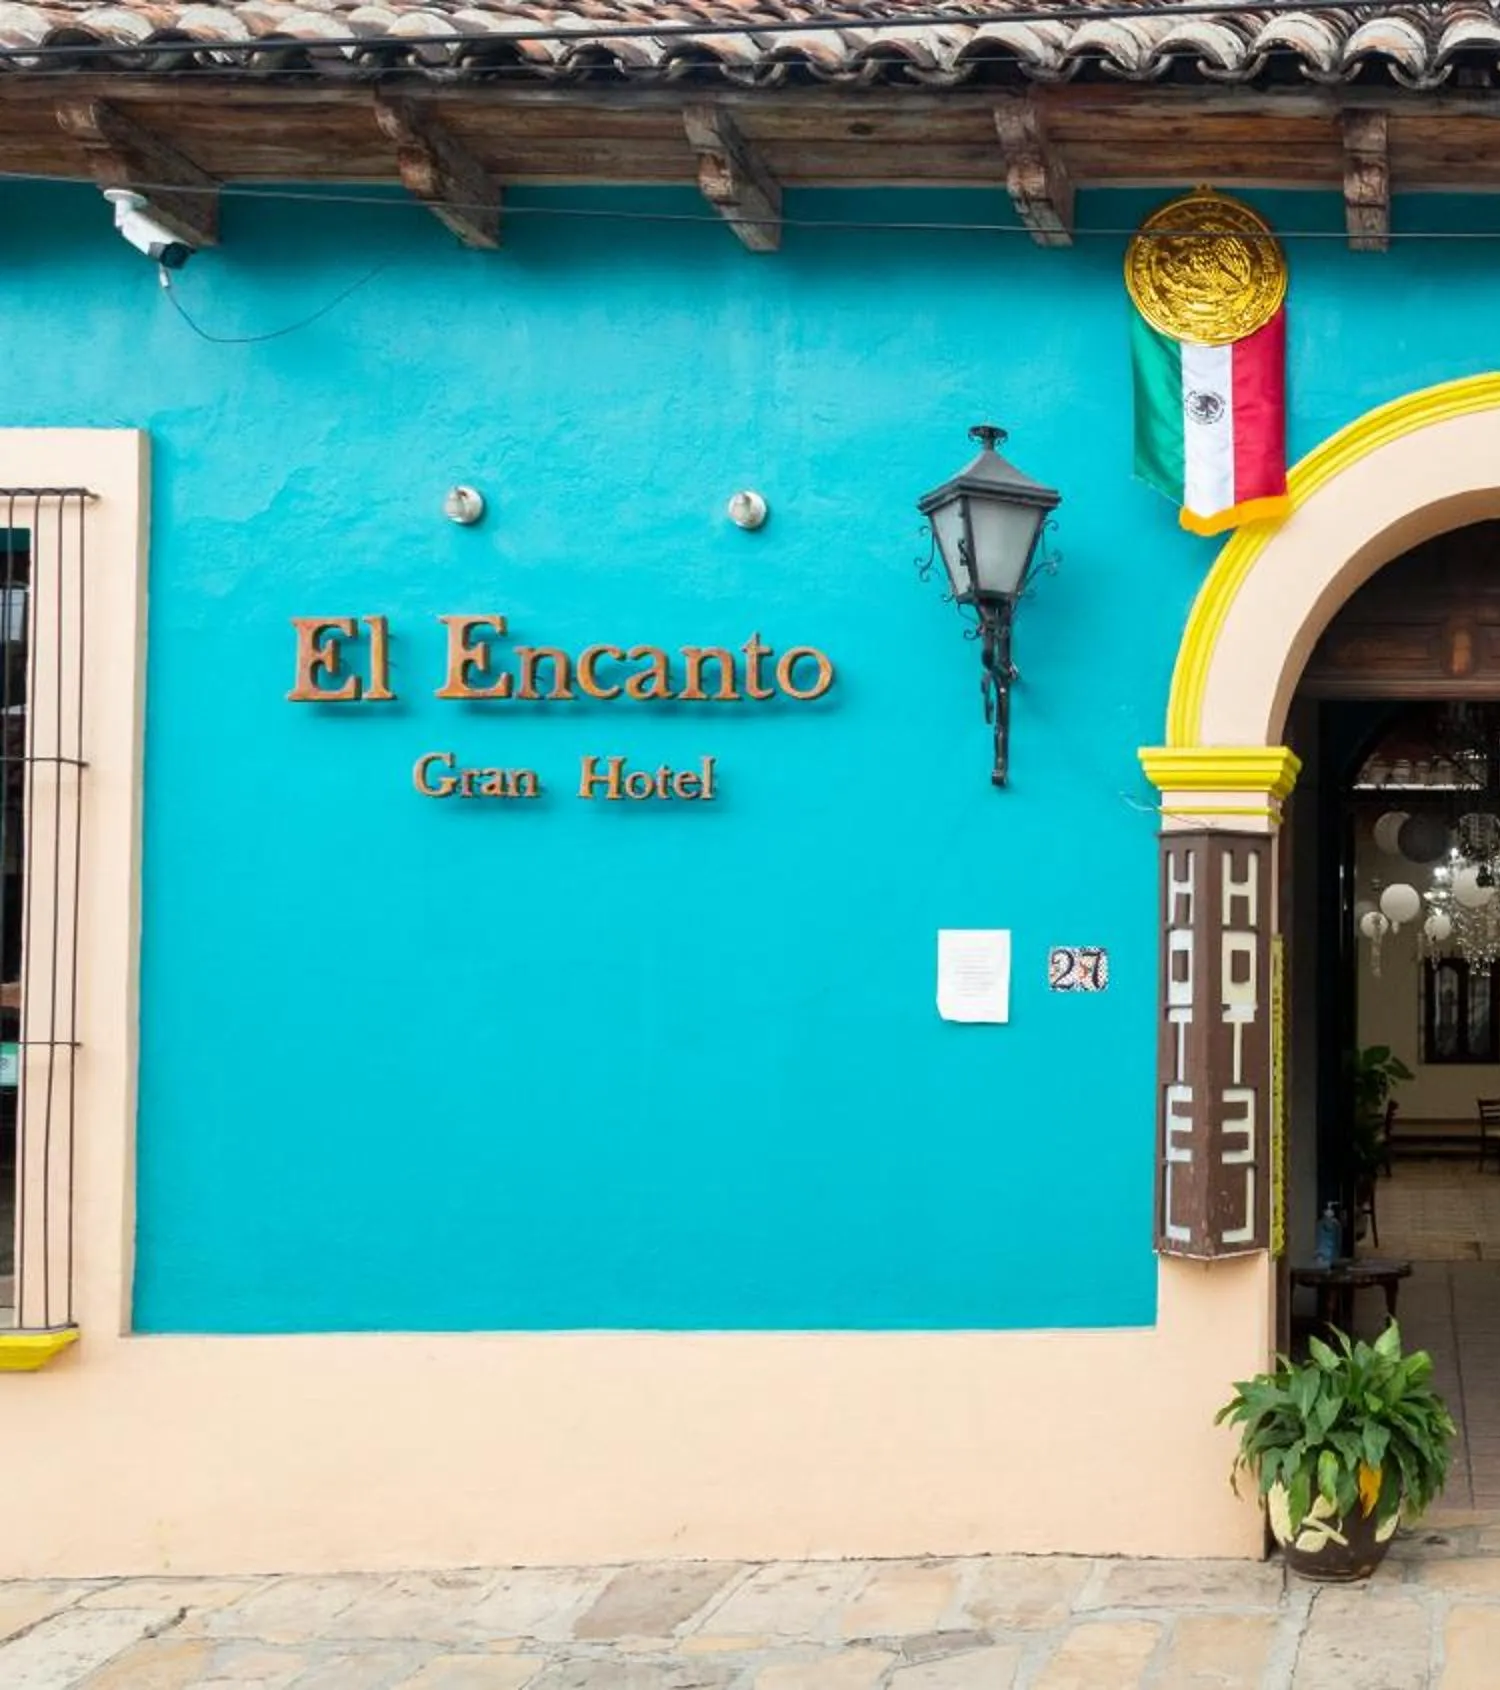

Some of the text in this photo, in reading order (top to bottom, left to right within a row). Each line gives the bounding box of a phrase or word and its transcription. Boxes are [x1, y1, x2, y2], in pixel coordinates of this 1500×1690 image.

[287, 613, 836, 701] El Encanto
[412, 752, 716, 800] Gran Hotel
[1050, 948, 1103, 991] 27
[1165, 851, 1195, 1243] HOTEL
